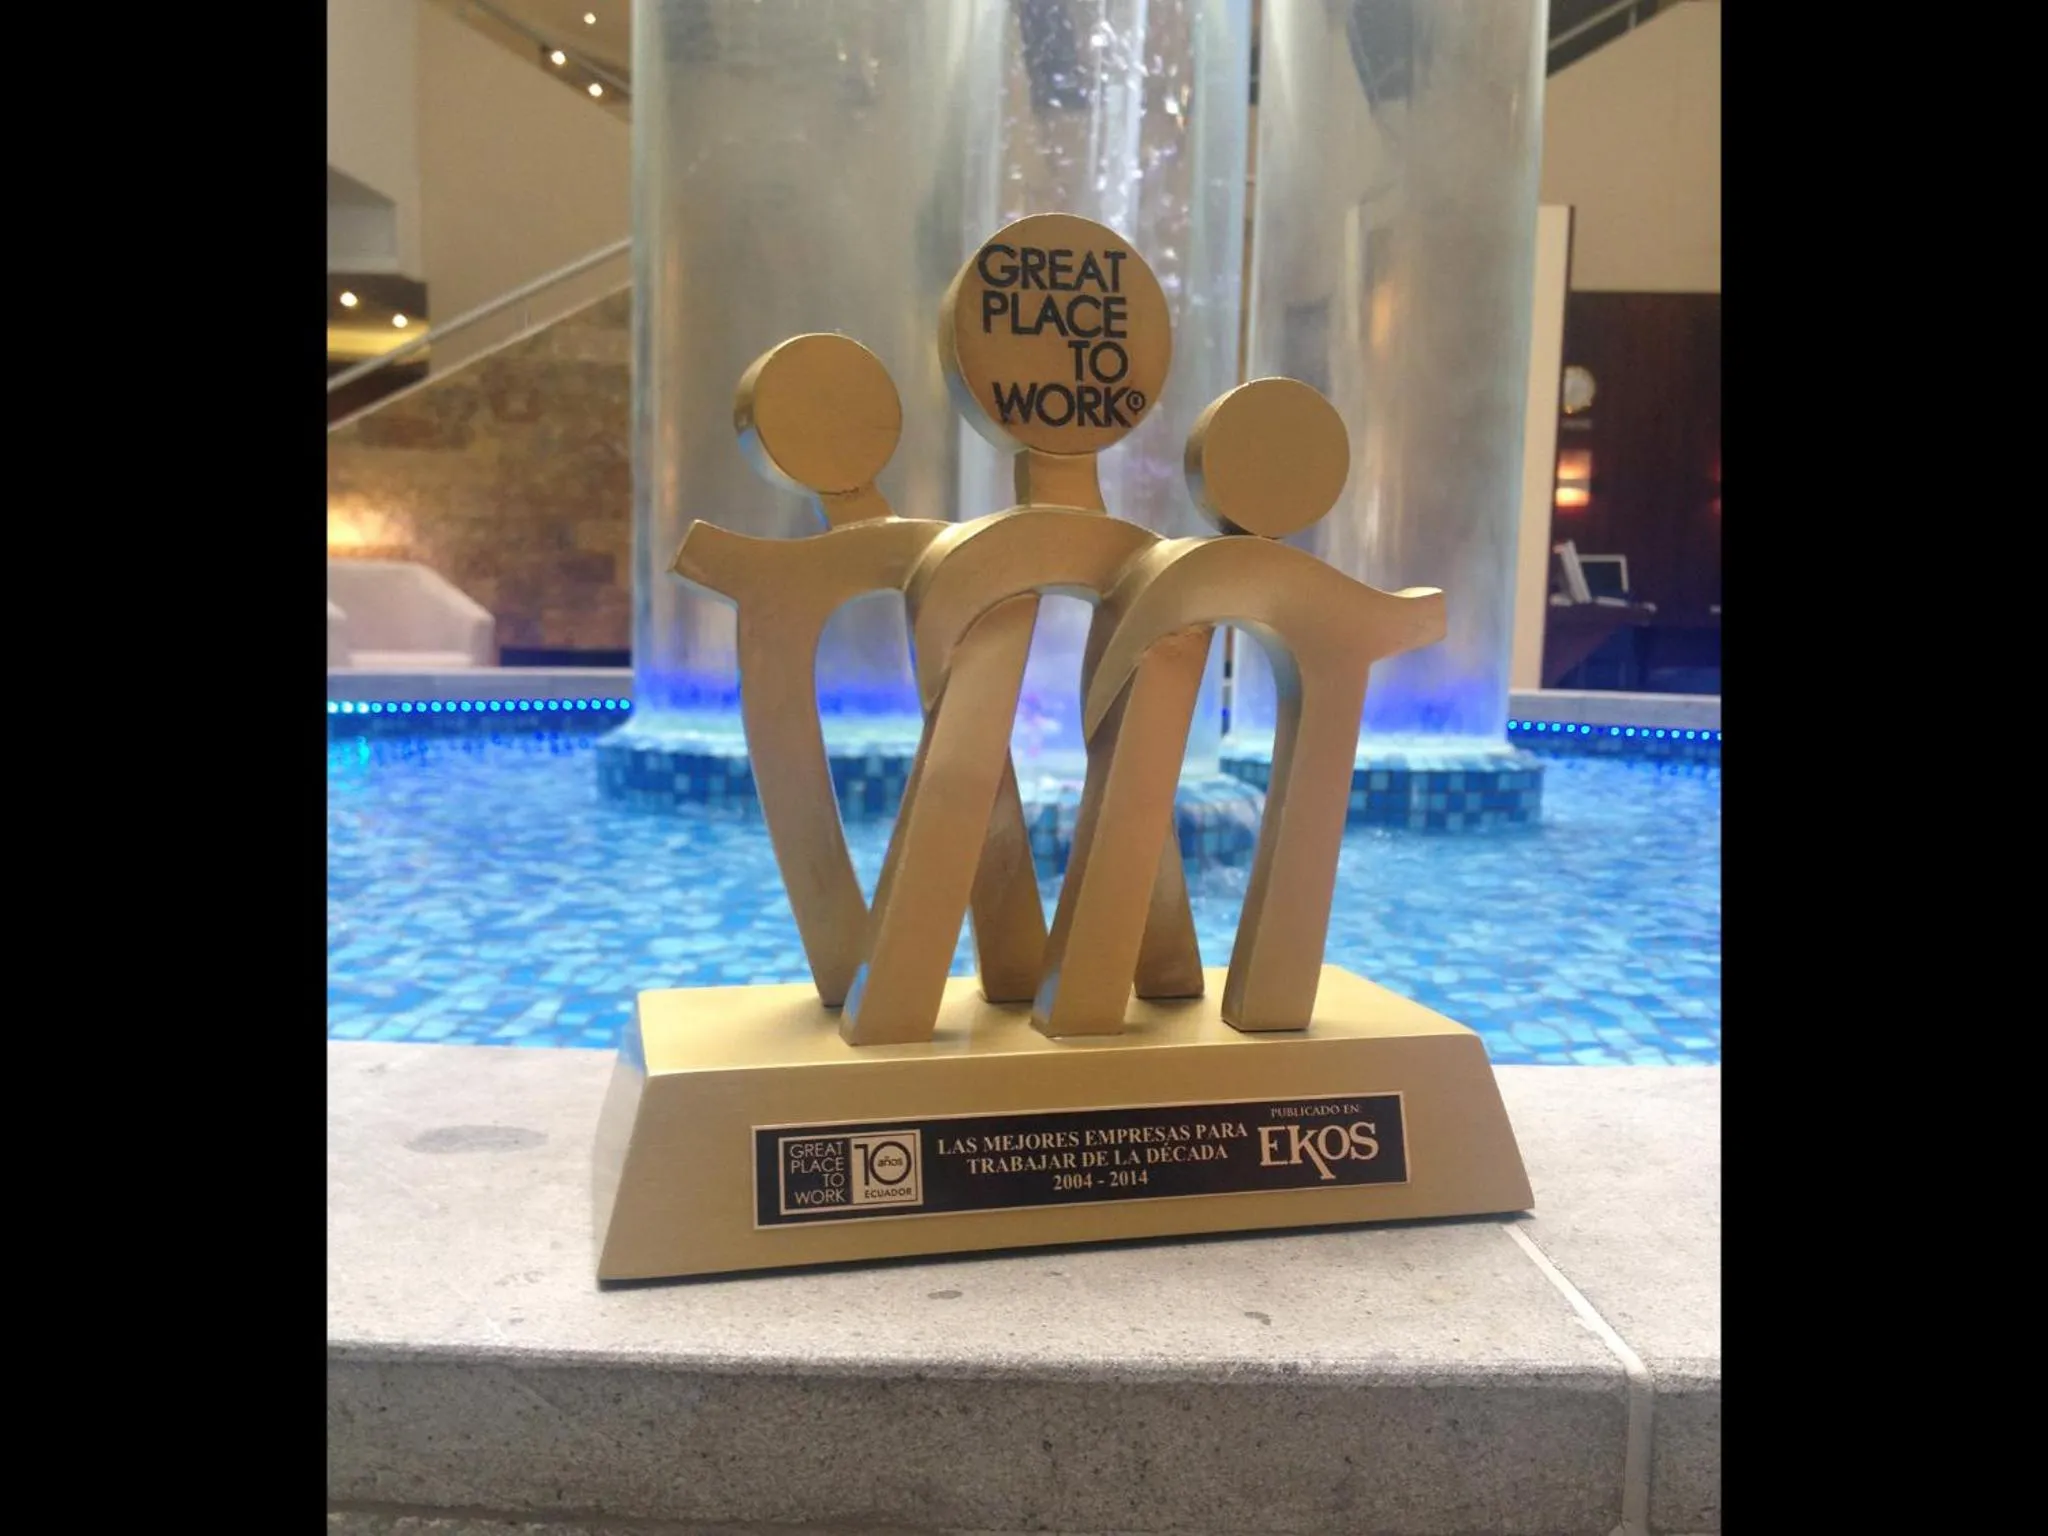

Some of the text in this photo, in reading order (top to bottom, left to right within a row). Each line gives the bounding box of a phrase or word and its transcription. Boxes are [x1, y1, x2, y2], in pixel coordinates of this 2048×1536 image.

[978, 244, 1126, 292] GREAT
[982, 290, 1128, 339] PLACE
[1067, 340, 1129, 383] TO
[1271, 1105, 1340, 1118] PUBLICADO
[790, 1142, 843, 1158] GREAT
[938, 1122, 1248, 1155] LAS MEJORES EMPRESAS PARA
[877, 1156, 903, 1168] años
[967, 1142, 1229, 1175] TRABAJAR DE LA DÉCADA
[1257, 1122, 1379, 1180] EKOS
[791, 1158, 844, 1173] PLACE
[854, 1141, 911, 1186] 10
[823, 1173, 844, 1187] TO
[1053, 1171, 1094, 1191] 2004
[1109, 1168, 1149, 1187] 2014
[794, 1188, 846, 1205] WORK
[865, 1187, 912, 1198] ECUADOR
